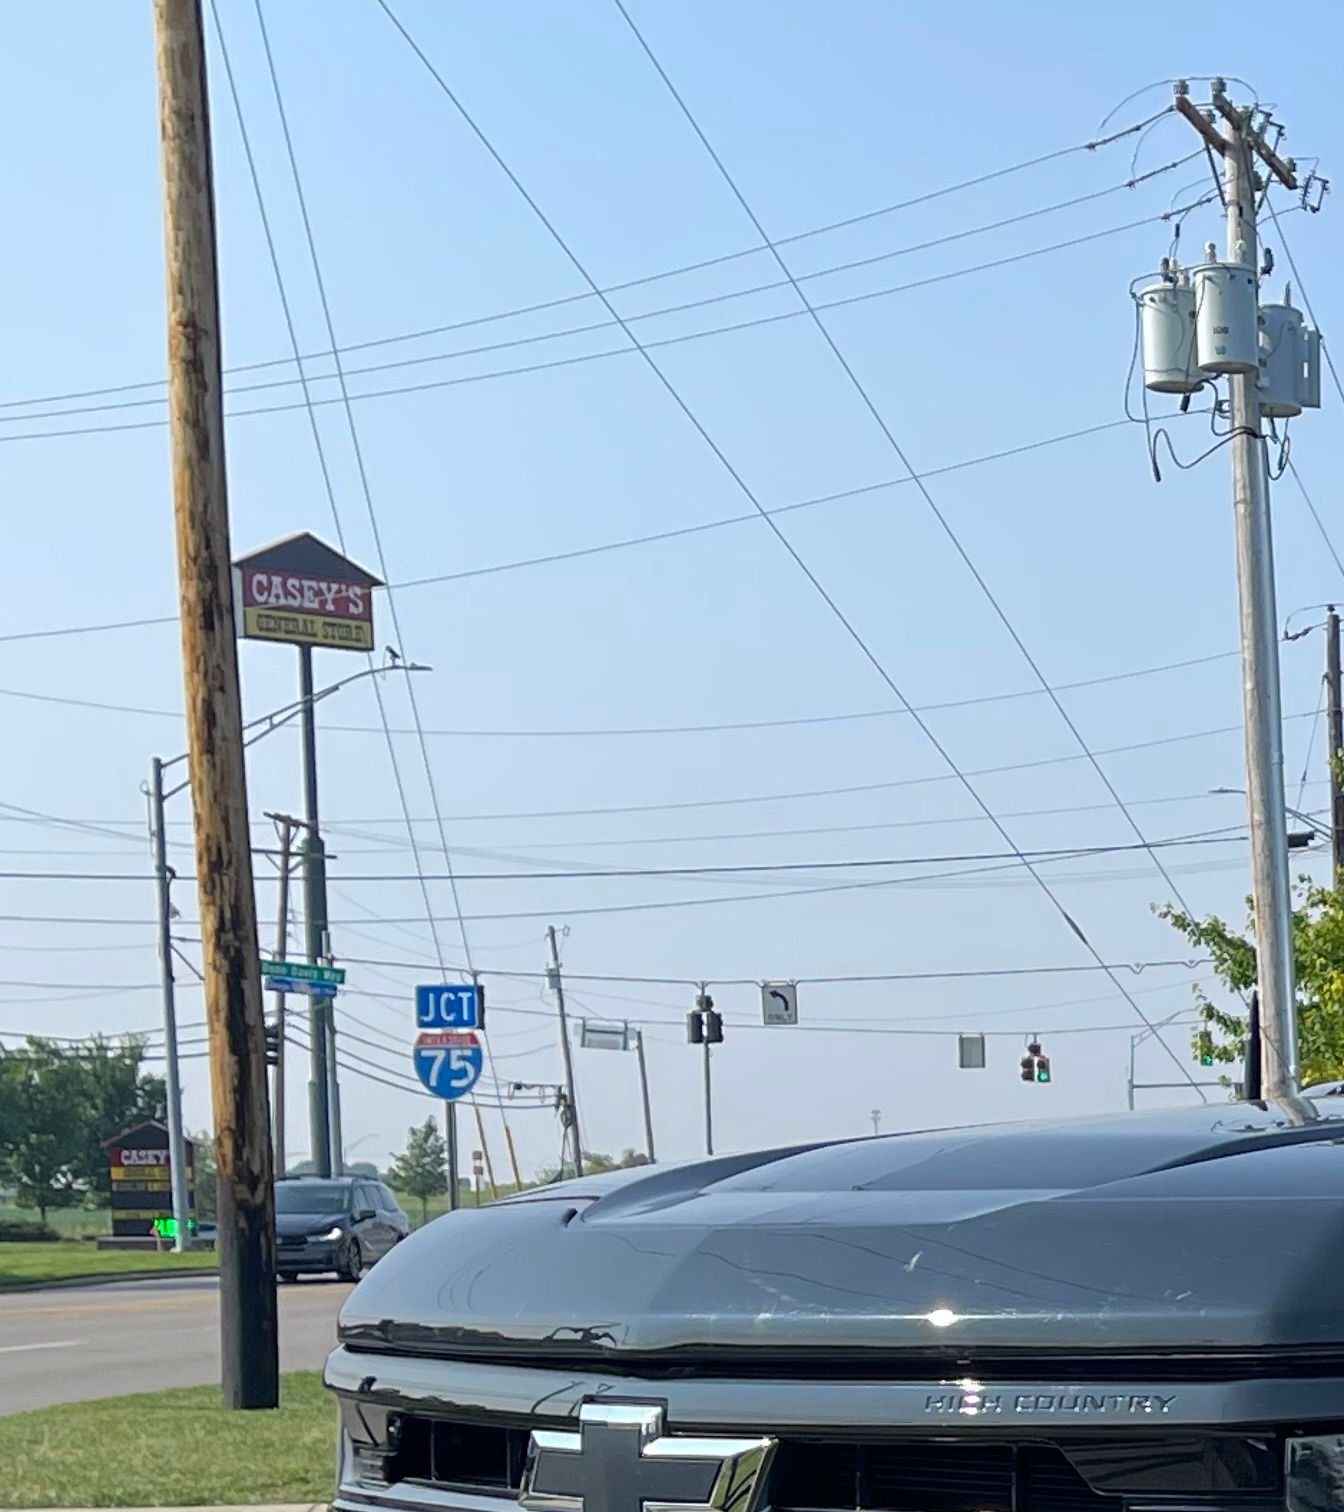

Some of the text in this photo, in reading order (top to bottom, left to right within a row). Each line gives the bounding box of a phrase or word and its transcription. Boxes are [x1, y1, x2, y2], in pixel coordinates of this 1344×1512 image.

[251, 573, 364, 615] CASEY'S
[256, 613, 318, 638] GENERAL
[420, 991, 473, 1022] JCT
[768, 1013, 793, 1021] ONLY
[420, 1049, 475, 1088] 75
[121, 1149, 170, 1166] CASEY
[925, 1394, 1178, 1414] HIGH COUNTRY
